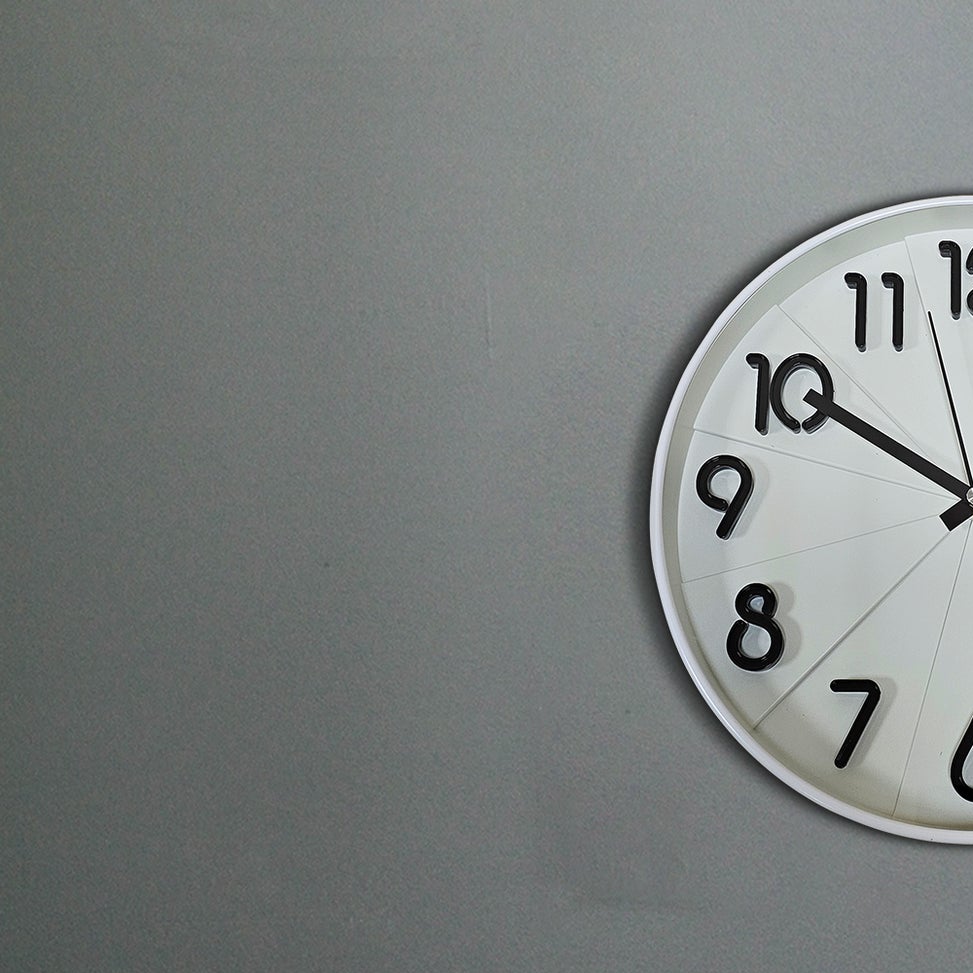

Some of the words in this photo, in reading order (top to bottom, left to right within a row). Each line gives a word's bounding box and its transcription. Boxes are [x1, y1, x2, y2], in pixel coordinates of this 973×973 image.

[844, 272, 905, 351] 11
[745, 352, 835, 434] 10
[695, 454, 754, 540] 9
[726, 582, 785, 672] 8
[829, 679, 882, 770] 7
